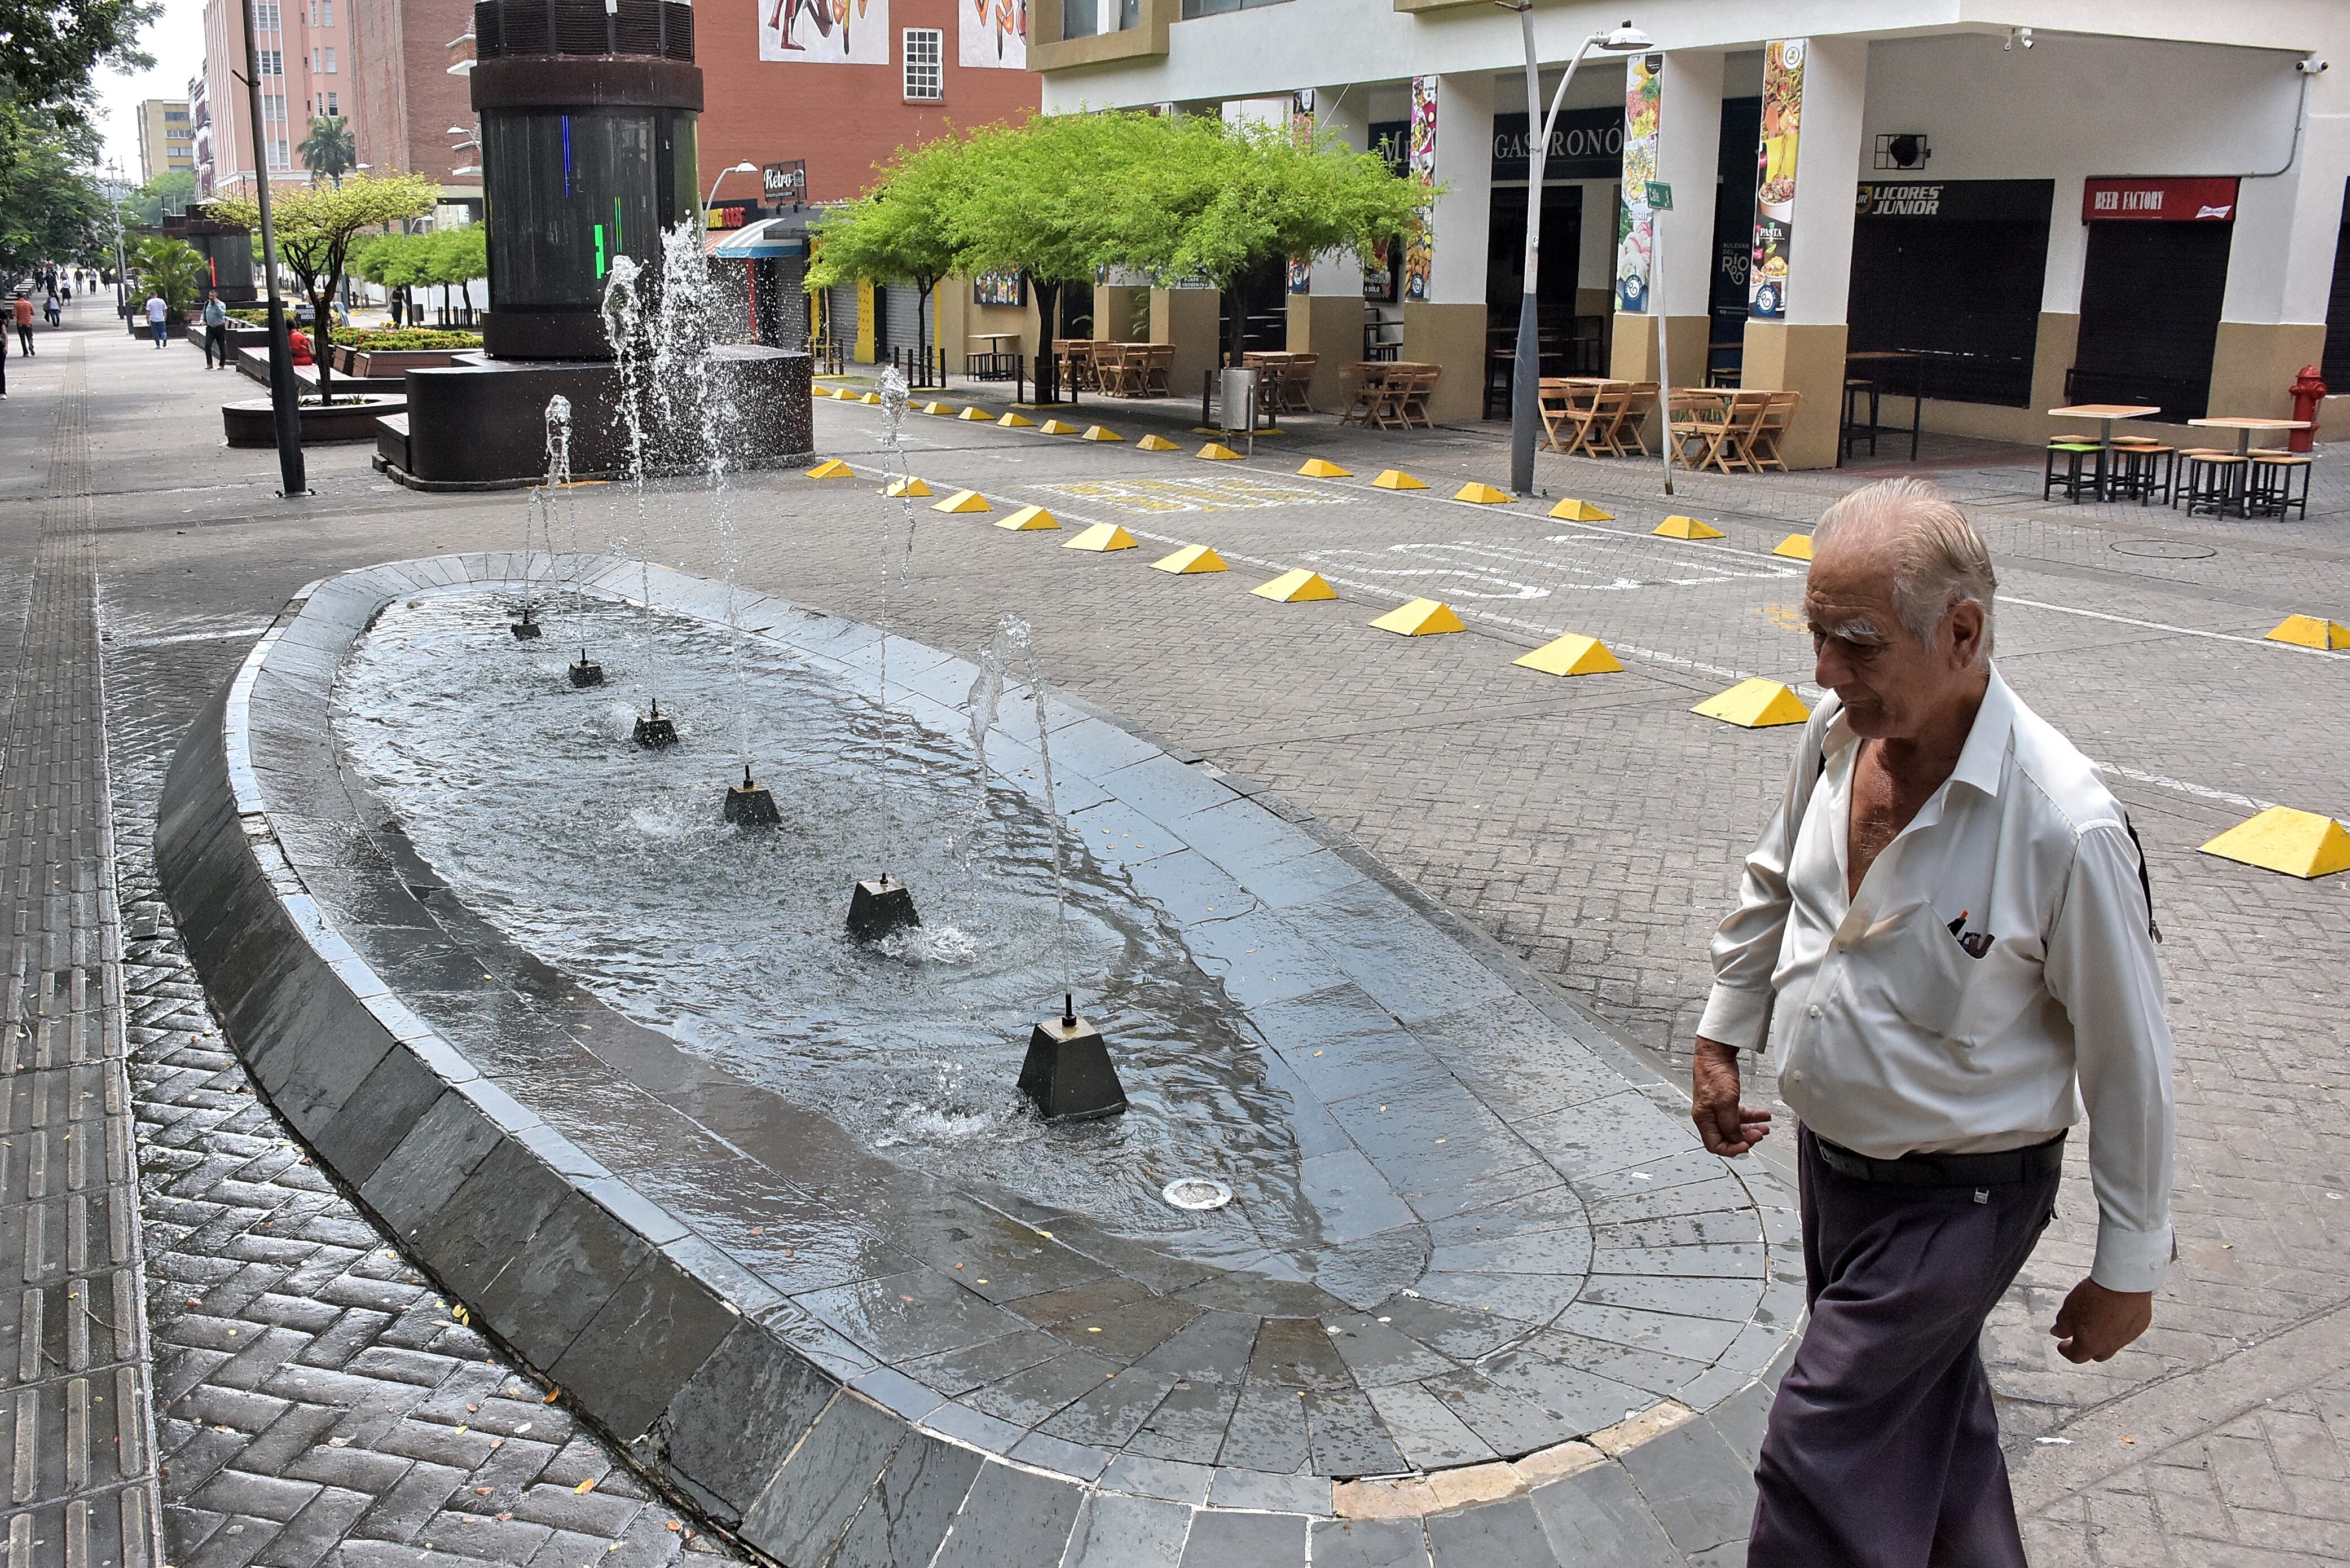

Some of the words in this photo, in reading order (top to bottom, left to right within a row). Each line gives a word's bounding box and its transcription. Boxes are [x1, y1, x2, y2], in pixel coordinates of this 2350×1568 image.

[764, 169, 793, 190] Retro
[1873, 187, 1940, 200] LICORES
[2094, 191, 2119, 210] BEER
[2123, 191, 2164, 210] FACTORY
[1872, 200, 1939, 214] JUNIOR
[1759, 228, 1782, 237] PASTA
